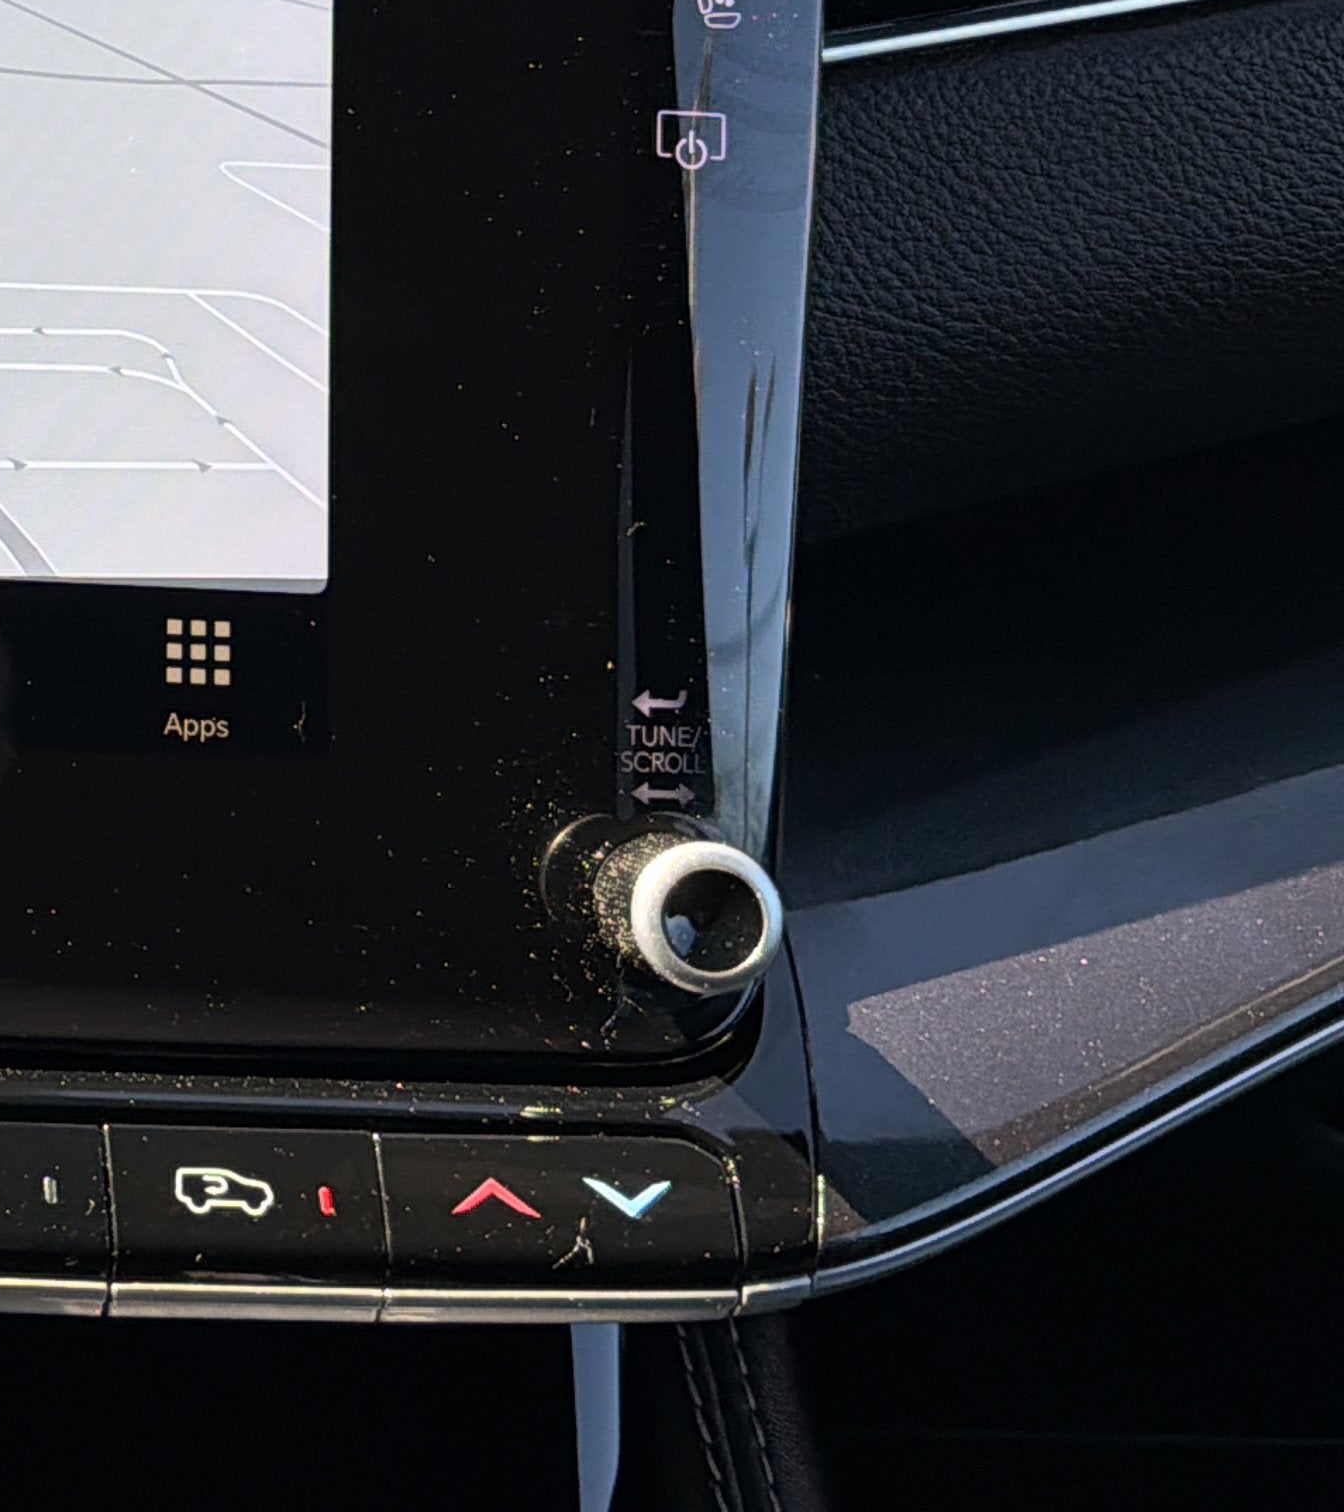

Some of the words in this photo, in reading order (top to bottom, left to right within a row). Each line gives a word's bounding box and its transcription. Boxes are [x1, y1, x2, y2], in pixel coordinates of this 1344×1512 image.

[163, 712, 230, 740] Apps
[626, 725, 702, 751] TUNE/
[620, 752, 706, 774] SCROLL
